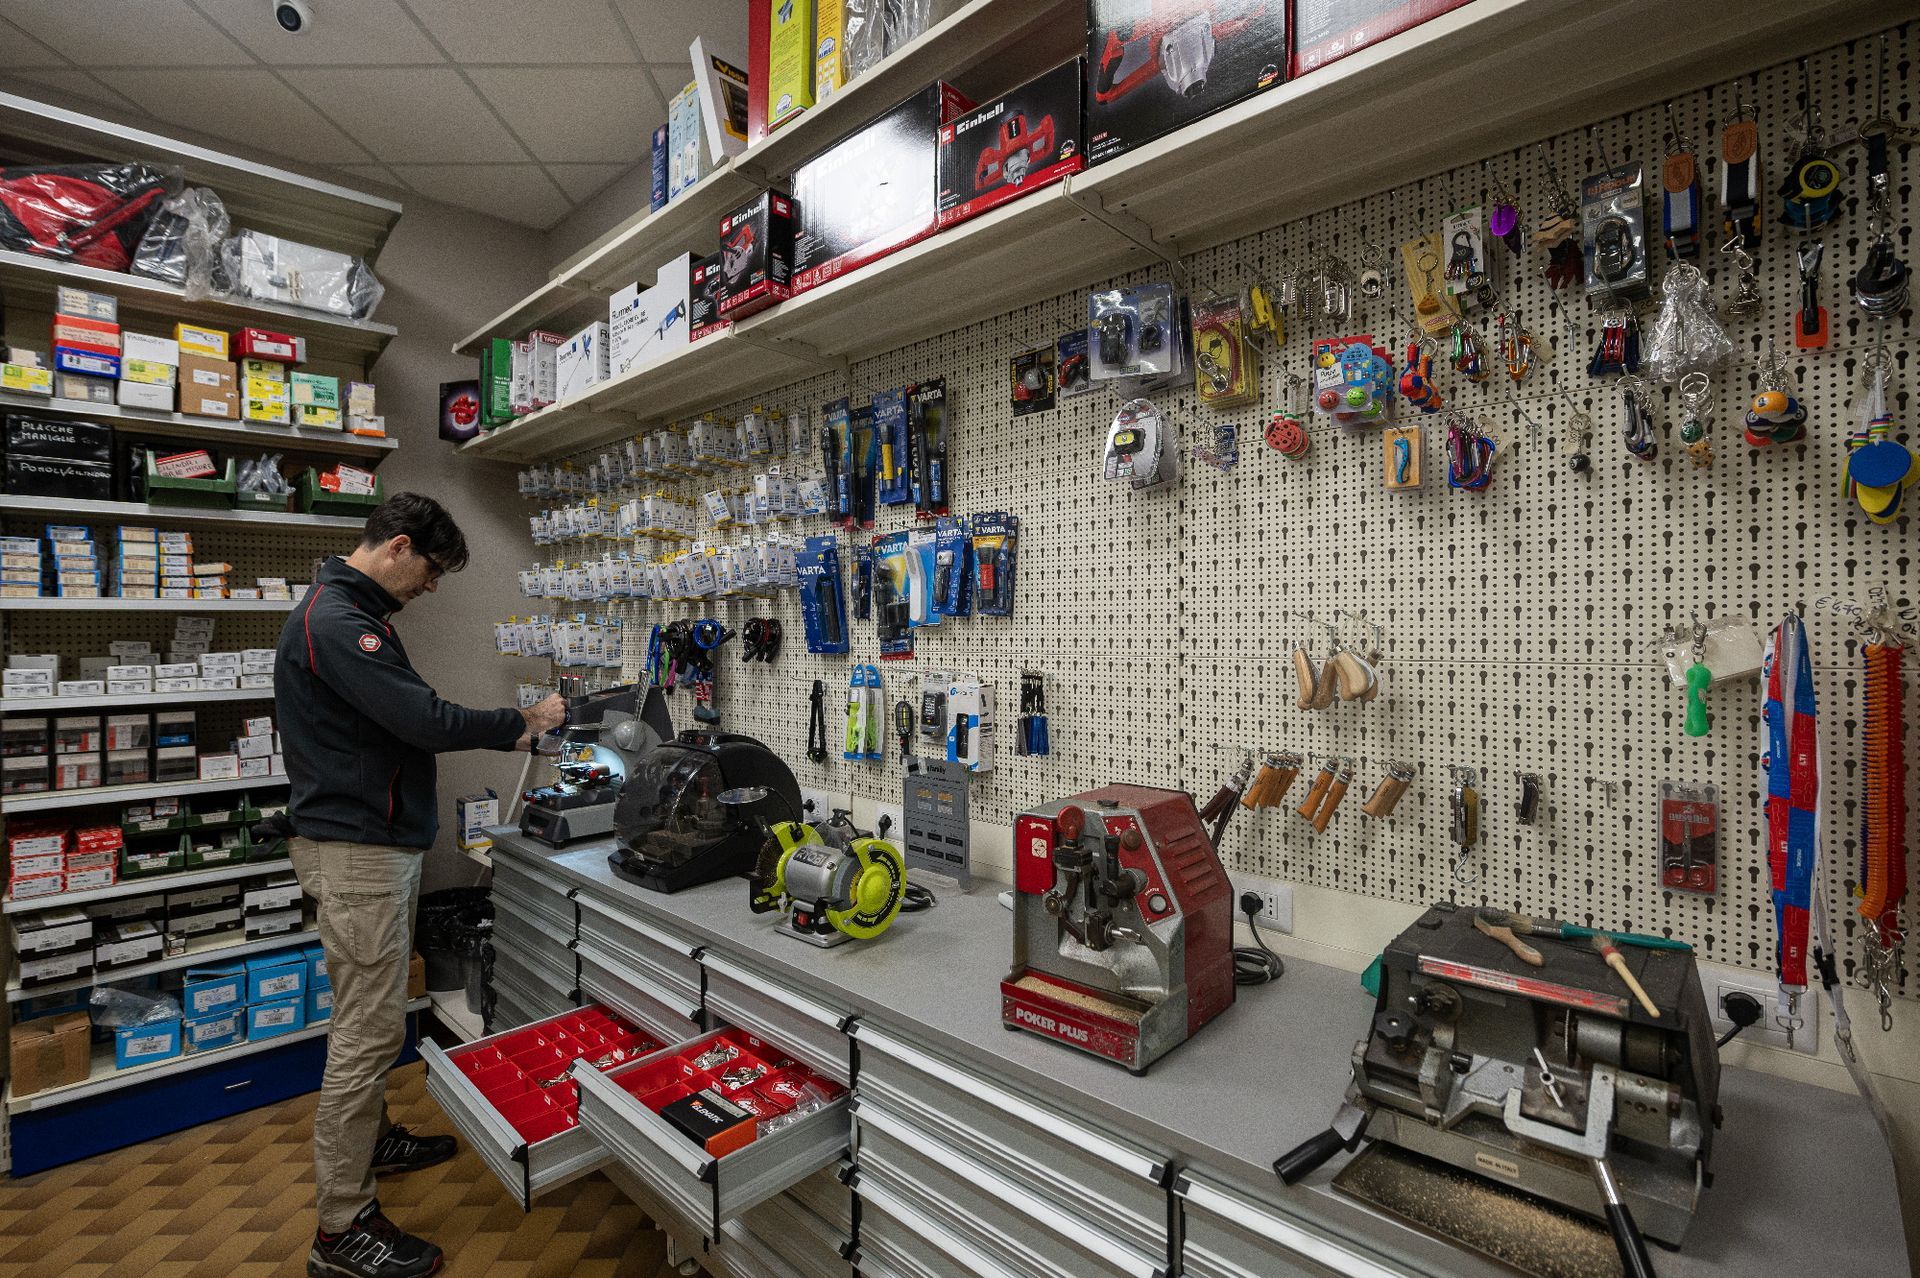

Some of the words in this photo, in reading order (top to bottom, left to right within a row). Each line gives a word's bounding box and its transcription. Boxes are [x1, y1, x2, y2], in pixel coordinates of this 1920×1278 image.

[956, 102, 1004, 135] Einhell
[917, 389, 943, 402] VARTA
[828, 409, 848, 422] VARTA
[875, 404, 904, 419] VARTA
[937, 529, 963, 538] VARTA
[982, 526, 1006, 534] VARTA
[881, 541, 909, 555] VARTA
[796, 566, 827, 576] VARTA
[1015, 1007, 1056, 1032] POKER
[1058, 1022, 1089, 1042] PLUS
